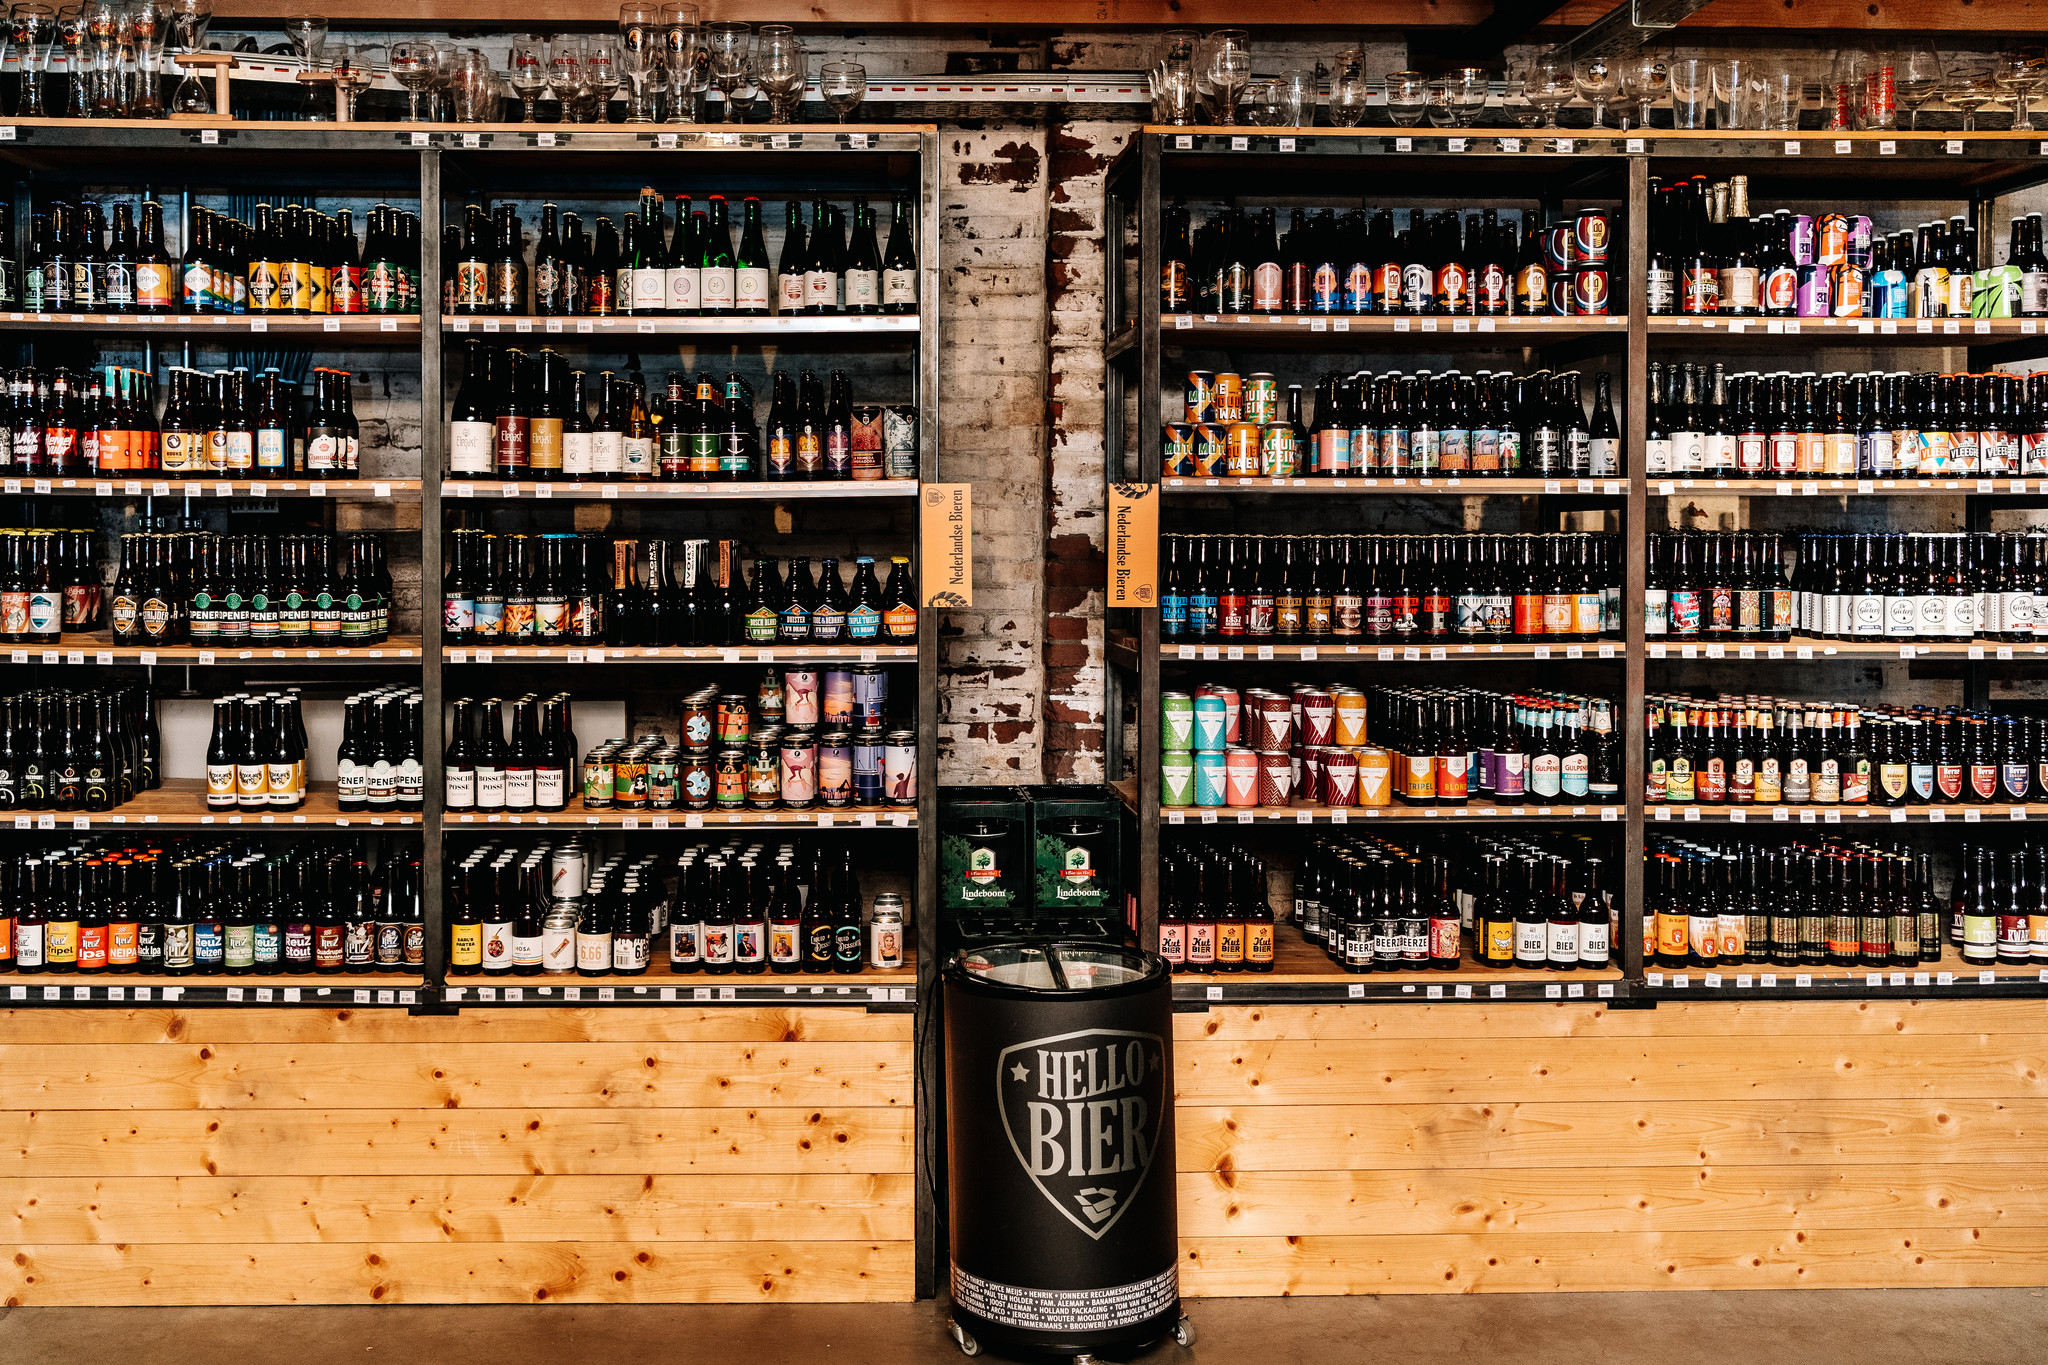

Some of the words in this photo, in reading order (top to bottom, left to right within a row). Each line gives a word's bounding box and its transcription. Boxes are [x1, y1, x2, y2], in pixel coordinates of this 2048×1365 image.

[948, 489, 963, 522] Bieren
[1116, 505, 1132, 566] Nederlandse
[948, 522, 963, 586] Nederlandse
[1116, 568, 1131, 601] Bieren
[1509, 780, 1522, 788] IPA
[961, 886, 1006, 901] Lindeboom
[1056, 885, 1101, 900] Lindeboom
[1162, 938, 1181, 947] Kut
[1192, 937, 1211, 946] Kut
[1222, 937, 1241, 946] Kut
[1253, 937, 1272, 946] Kut
[1524, 940, 1541, 949] BIER
[1556, 942, 1574, 950] BIER
[1588, 941, 1606, 949] BIER
[47, 946, 74, 956] Tripel
[79, 949, 106, 960] Ipa
[110, 948, 138, 957] NEIPA
[195, 947, 223, 957] Weizen
[285, 946, 312, 956] Stout
[580, 945, 602, 961] 6.66
[1162, 946, 1181, 954] BIER
[1036, 1040, 1145, 1100] HELLO
[1027, 1095, 1152, 1177] BIER
[989, 1283, 1005, 1293] JOYCE
[1005, 1287, 1023, 1297] MEIJS
[1029, 1291, 1054, 1300] HENRIK
[1060, 1292, 1089, 1301] JONNEKE
[1090, 1280, 1153, 1299] RECLAMESPECIALISTEN
[983, 1289, 997, 1298] PAUL
[997, 1293, 1008, 1301] TEN
[1009, 1296, 1034, 1305] HOLDER
[1040, 1299, 1056, 1307] FAM.
[1057, 1299, 1085, 1307] ALEMAN
[1091, 1290, 1146, 1306] BANANENHANGMAT
[989, 1298, 1006, 1308] JOOST
[1007, 1303, 1032, 1313] ALEMAN
[1039, 1306, 1070, 1315] HOLLAND
[1071, 1306, 1108, 1315] PACKAGING
[1115, 1302, 1128, 1311] TOM
[1129, 1299, 1140, 1308] VAN
[990, 1306, 1006, 1315] ARCO
[1012, 1311, 1039, 1322] JEROENG
[1047, 1314, 1075, 1323] WOUTER
[1077, 1312, 1110, 1323] MOOLDIJK
[999, 1315, 1017, 1325] HENRI
[1018, 1319, 1063, 1330] TIMMERMANS
[1069, 1320, 1106, 1331] BROUWERIJ
